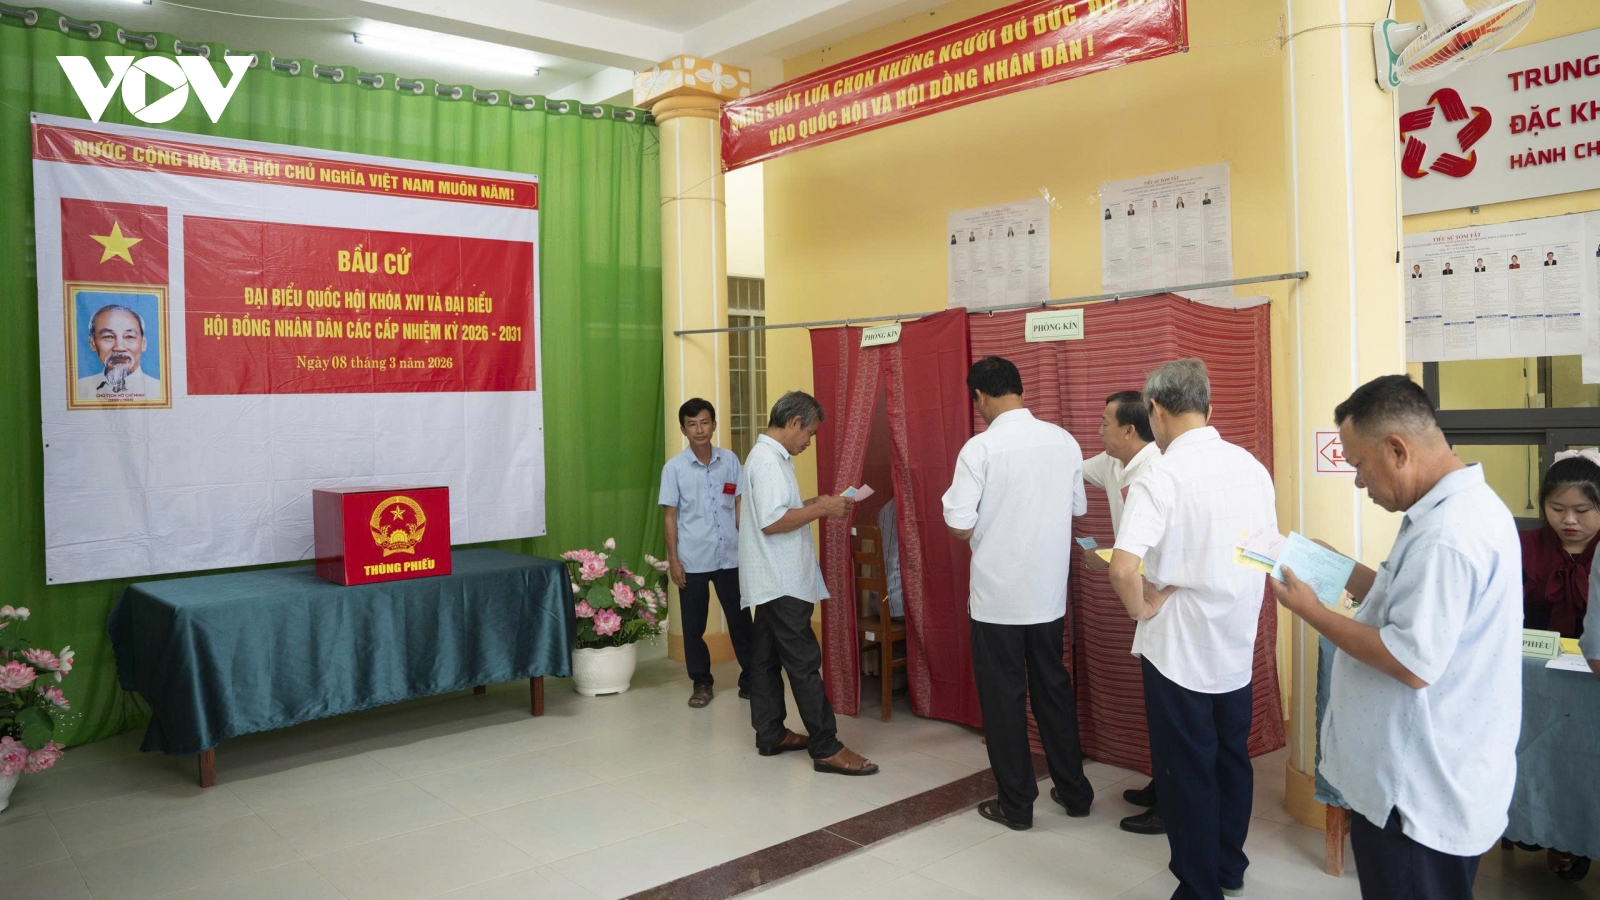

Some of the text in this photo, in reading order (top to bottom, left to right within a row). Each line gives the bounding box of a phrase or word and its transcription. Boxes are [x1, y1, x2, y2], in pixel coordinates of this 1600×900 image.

[766, 91, 801, 119] SUỐT
[805, 83, 830, 108] LỰA
[833, 69, 875, 94] CHỌN
[878, 49, 935, 83] NHỮNG
[938, 29, 996, 62] NGƯỜI
[1000, 16, 1028, 45] ĐỦ
[1508, 55, 1600, 91] TRUNG
[769, 123, 796, 147] VÀO
[799, 107, 838, 138] QUỐC
[841, 101, 868, 126] HỘI
[871, 92, 893, 117] VÀ
[896, 83, 925, 109] HỘI
[929, 70, 978, 99] ĐỒNG
[983, 53, 1036, 84] NHÂN
[1041, 41, 1084, 69] DÂN
[1509, 104, 1562, 136] ĐẶC
[74, 139, 515, 200] NƯỚC CỘNG HÒA XÃ HỘI CHỦ NGHĨA VIỆT NAM MUÔN NĂM!
[1510, 147, 1566, 170] HÀNH
[338, 243, 412, 275] BẦU CỬ
[244, 282, 493, 316] ĐẠI BIỂU QUỐC HỘI KHÓA XVI VÀ ĐẠI BIỂU
[203, 313, 228, 340] HỘI
[232, 312, 271, 337] ĐỒNG
[274, 316, 312, 338] NHÂN
[316, 317, 343, 338] DÂN
[346, 318, 372, 339] CÁC
[374, 317, 399, 340] CẤP
[402, 320, 441, 343] NHIỆM
[444, 321, 459, 341] KỲ
[461, 324, 489, 341] 2026
[498, 325, 522, 342] 2031
[864, 329, 898, 341] PHÒNG KÍN
[1033, 320, 1077, 332] PHÒNG KÍN
[296, 355, 454, 371] Ngày 08 tháng 3 năm 2026
[364, 557, 436, 576] THÙNG PHIẾU
